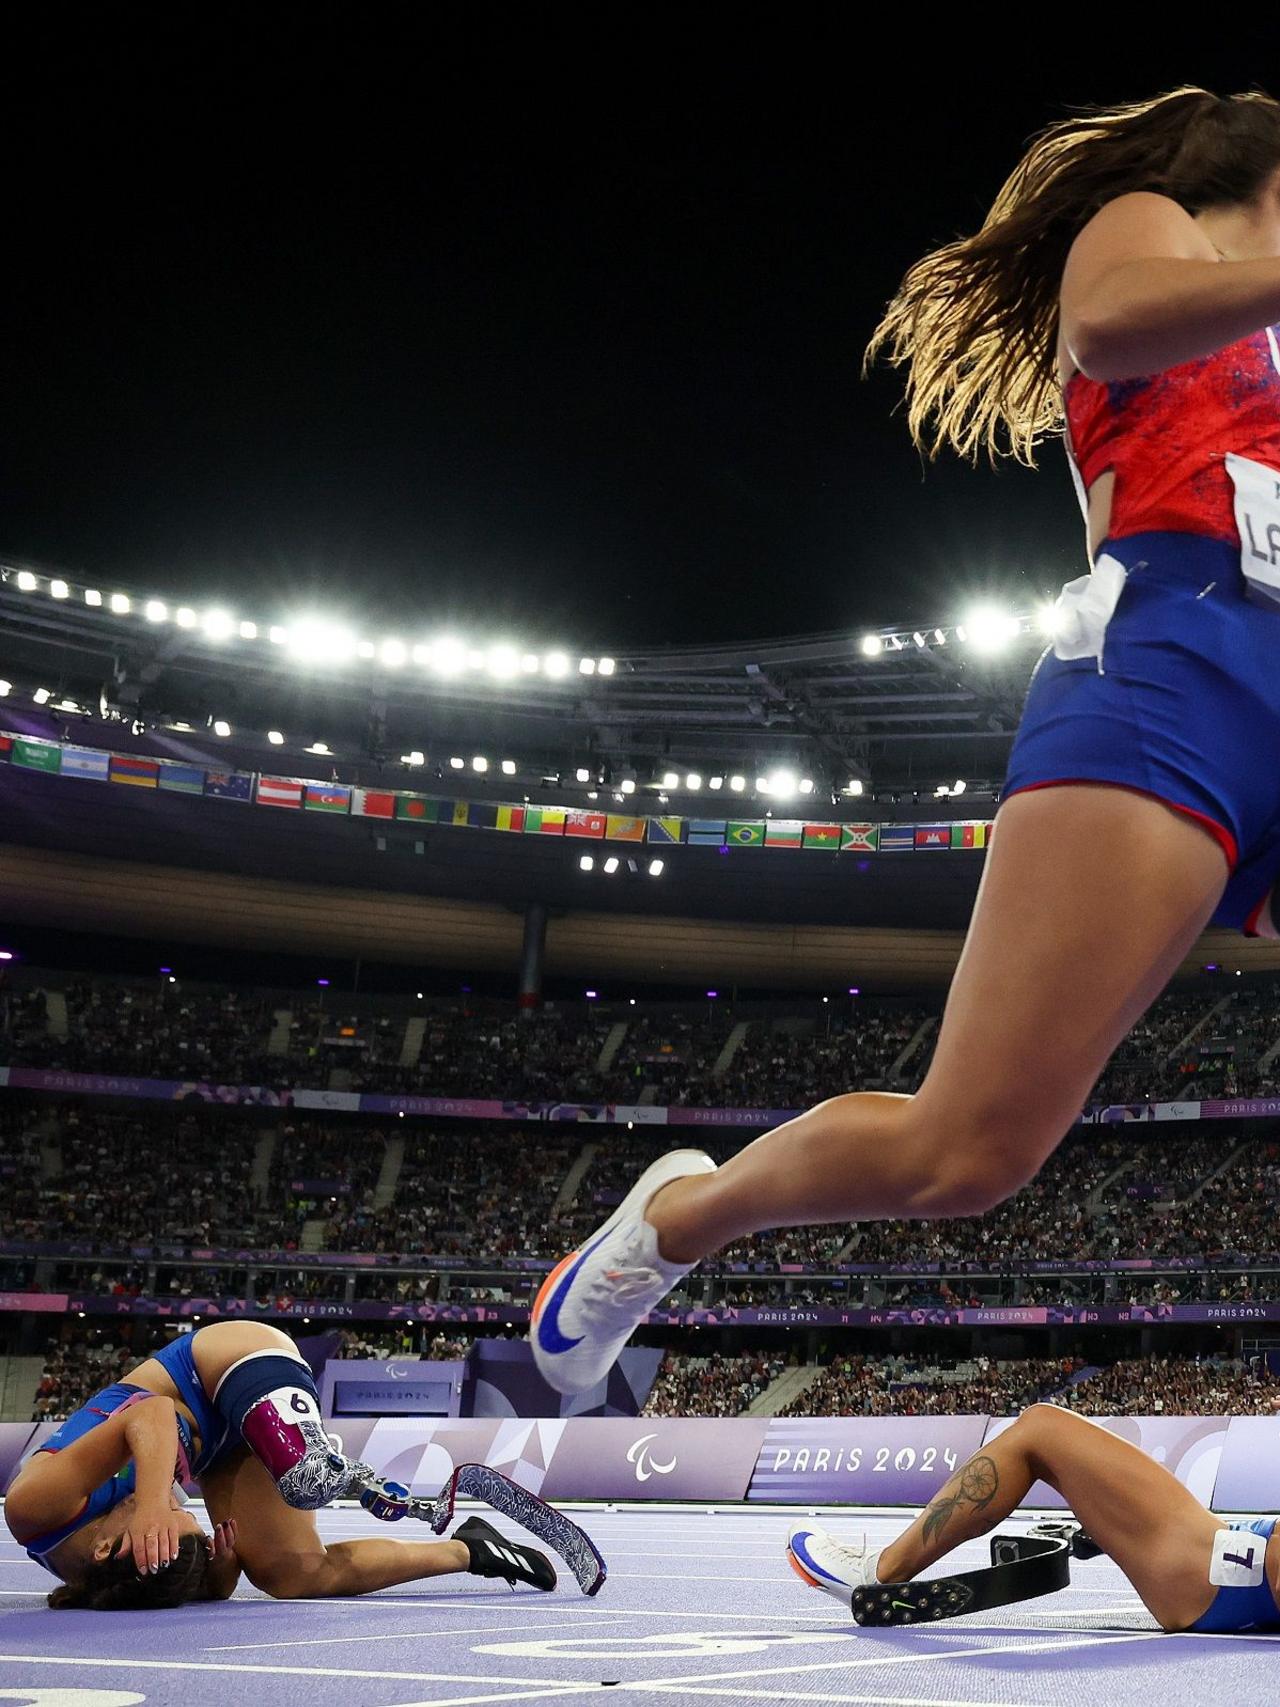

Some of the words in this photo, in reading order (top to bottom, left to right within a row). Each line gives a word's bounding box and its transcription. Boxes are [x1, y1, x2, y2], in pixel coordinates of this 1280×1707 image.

[791, 1313, 818, 1321] 2024
[1008, 1311, 1033, 1320] 2024
[1240, 1308, 1266, 1317] 2024
[290, 1393, 310, 1414] 6
[872, 1448, 958, 1472] 2024
[1222, 1547, 1255, 1570] 7
